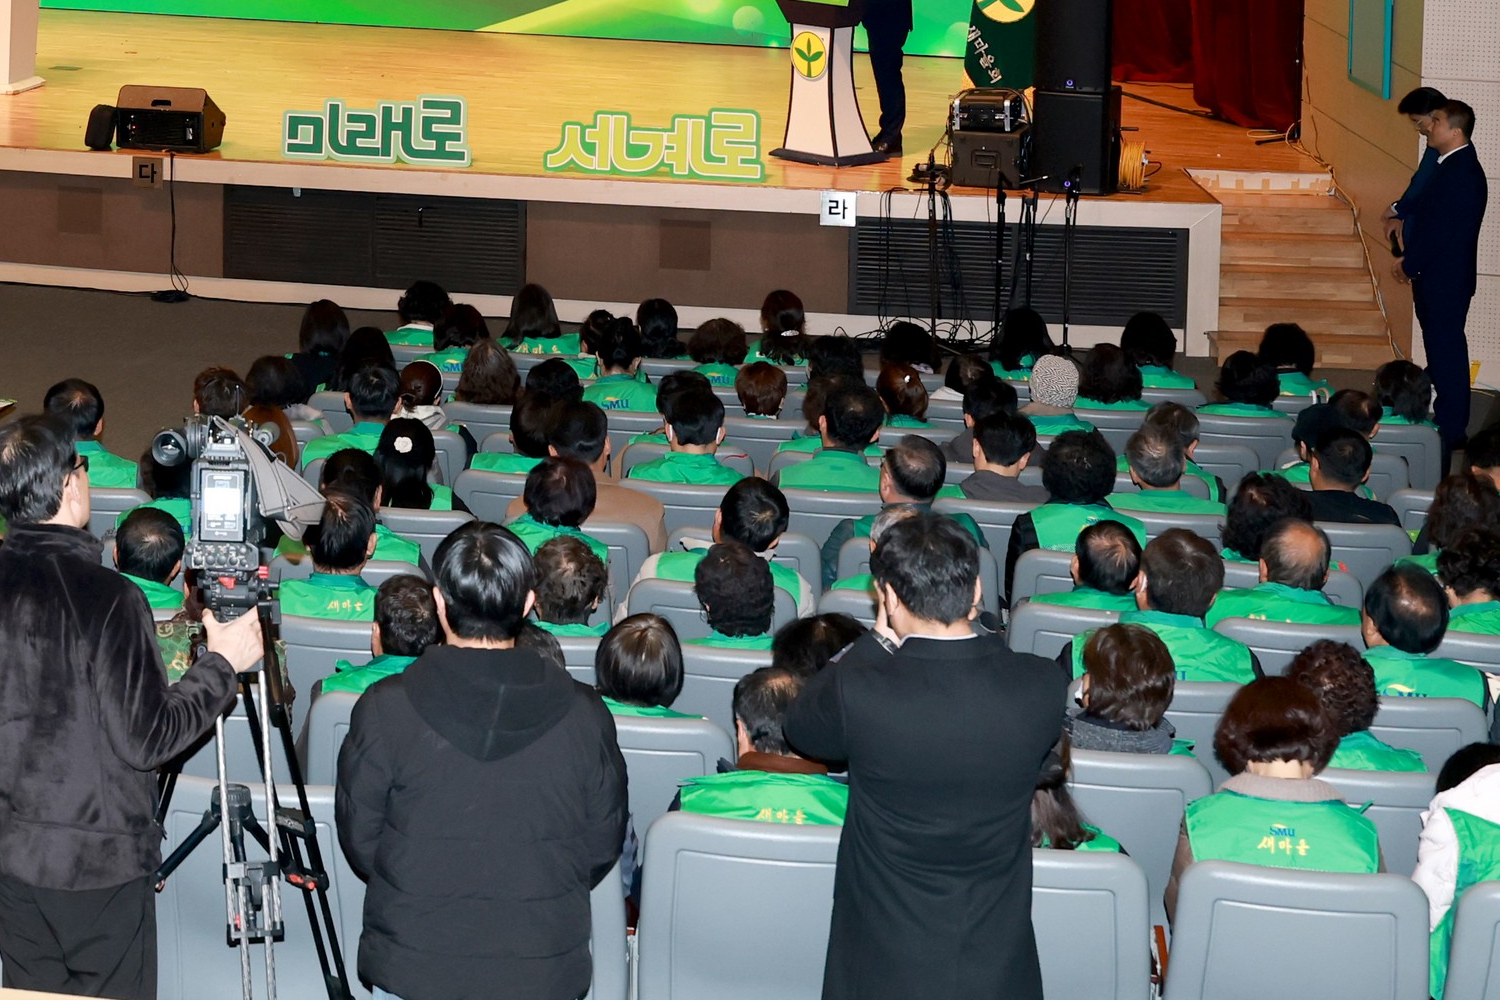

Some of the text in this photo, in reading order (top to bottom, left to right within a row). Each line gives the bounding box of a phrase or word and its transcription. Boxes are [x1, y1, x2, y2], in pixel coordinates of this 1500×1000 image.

[282, 95, 472, 167] 미래로
[544, 107, 766, 182] 세계로
[139, 162, 157, 184] 다
[829, 198, 847, 219] 라
[601, 399, 630, 411] SMU
[755, 807, 808, 825] 새마을
[1269, 826, 1296, 838] SMU
[1257, 836, 1311, 856] 새마을
